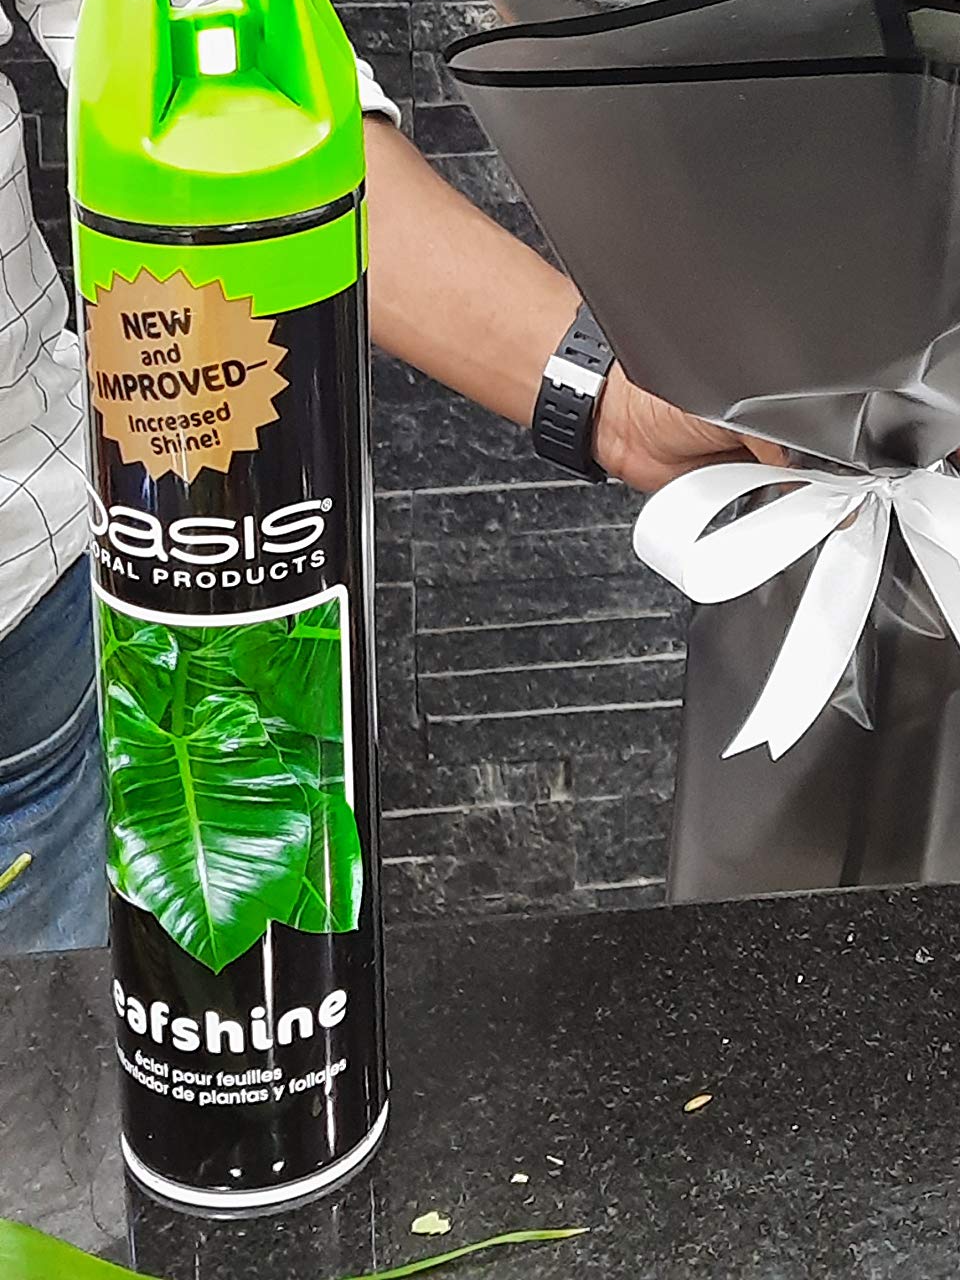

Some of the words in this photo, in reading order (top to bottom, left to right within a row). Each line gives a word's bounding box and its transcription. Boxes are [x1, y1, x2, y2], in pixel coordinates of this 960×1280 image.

[121, 307, 192, 341] NEW
[141, 343, 182, 366] and
[96, 359, 248, 403] IMPROVED
[128, 402, 232, 433] Increased
[150, 429, 221, 455] Shine!
[153, 549, 326, 589] PRODUCTS
[172, 1069, 213, 1086] pour
[216, 1067, 283, 1087] feuilles
[172, 1085, 195, 1101] de
[199, 1088, 269, 1106] plantas
[273, 1084, 286, 1101] y
